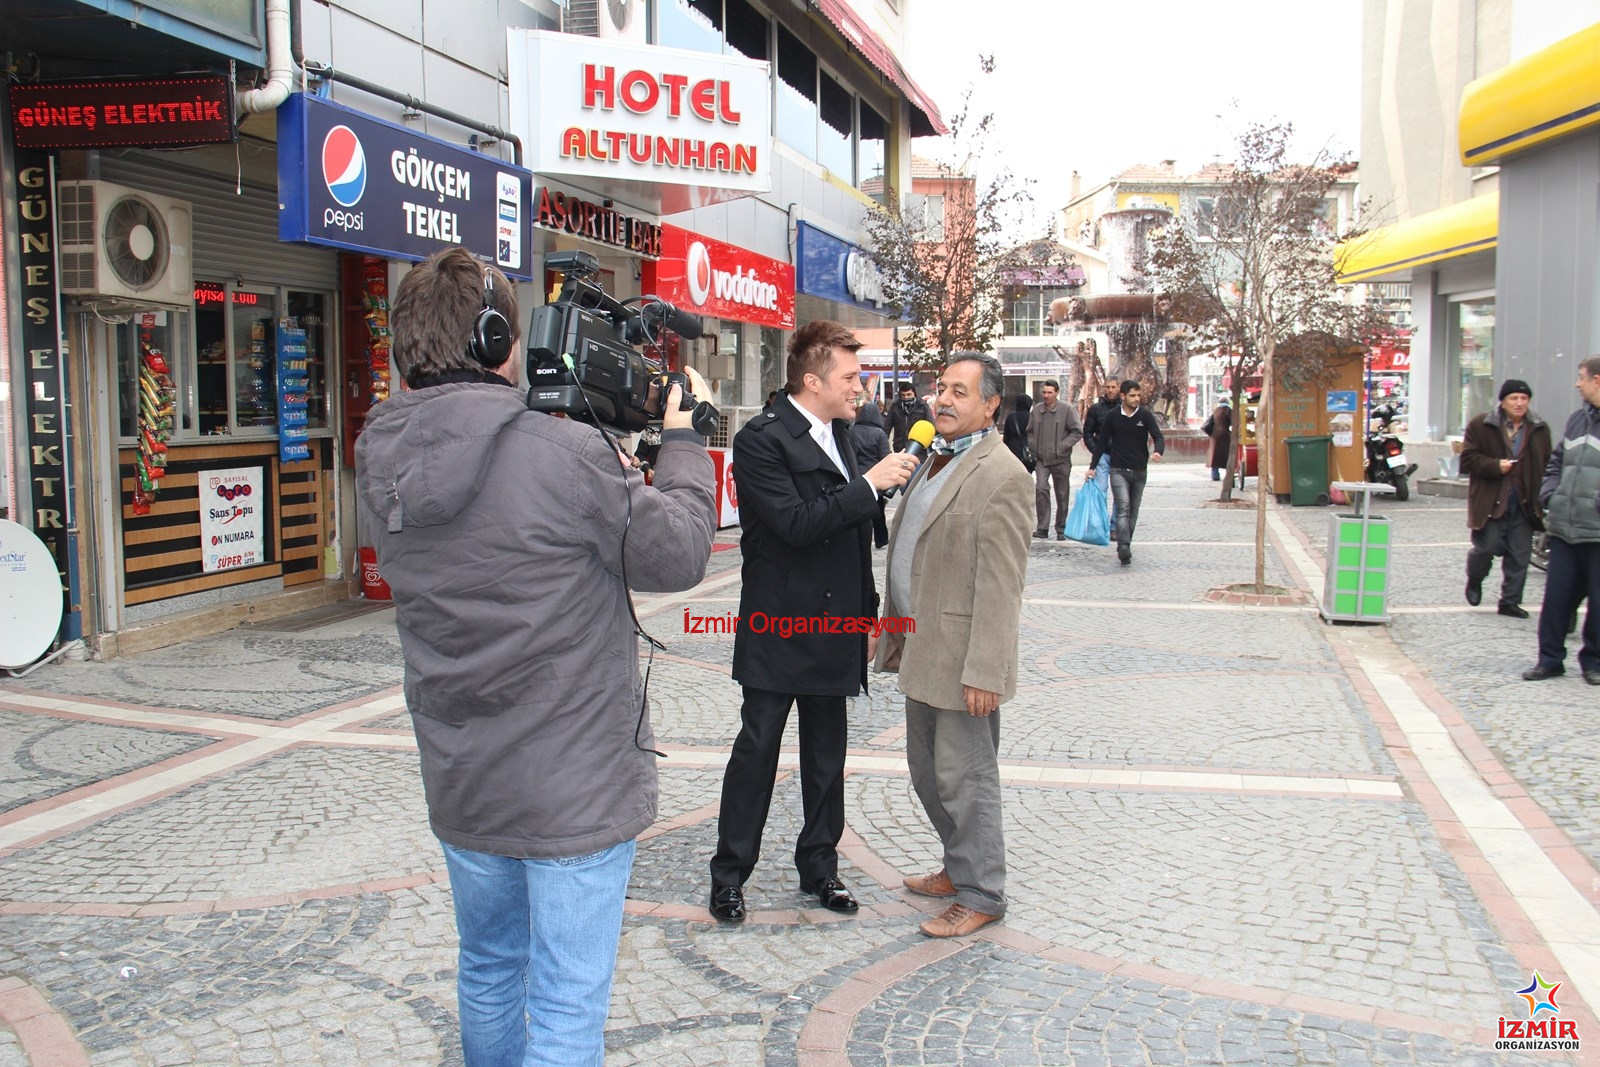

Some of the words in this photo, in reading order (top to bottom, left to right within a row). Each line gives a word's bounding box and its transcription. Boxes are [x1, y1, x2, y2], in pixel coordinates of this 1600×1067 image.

[581, 62, 741, 126] HOTEL
[18, 101, 97, 131] GÜNEŞ
[104, 95, 222, 125] ELEKTRİK
[560, 125, 758, 175] ALTUNHAN
[391, 147, 471, 203] GÖKÇEM
[324, 207, 364, 232] pepsi
[402, 201, 462, 244] TEKEL
[533, 186, 627, 246] ASORTİE
[627, 217, 664, 257] BAR
[19, 166, 51, 325] GÜNEŞ
[712, 265, 778, 311] vodafone
[581, 314, 593, 324] SONY
[589, 343, 599, 352] HD
[224, 475, 249, 484] SAYISAL
[217, 484, 252, 501] LOTO
[210, 508, 230, 522] Şans
[232, 506, 253, 520] Topu
[211, 534, 223, 546] ON
[224, 530, 255, 544] NUMARA
[0, 550, 26, 562] extStar
[217, 554, 242, 569] SÜPER
